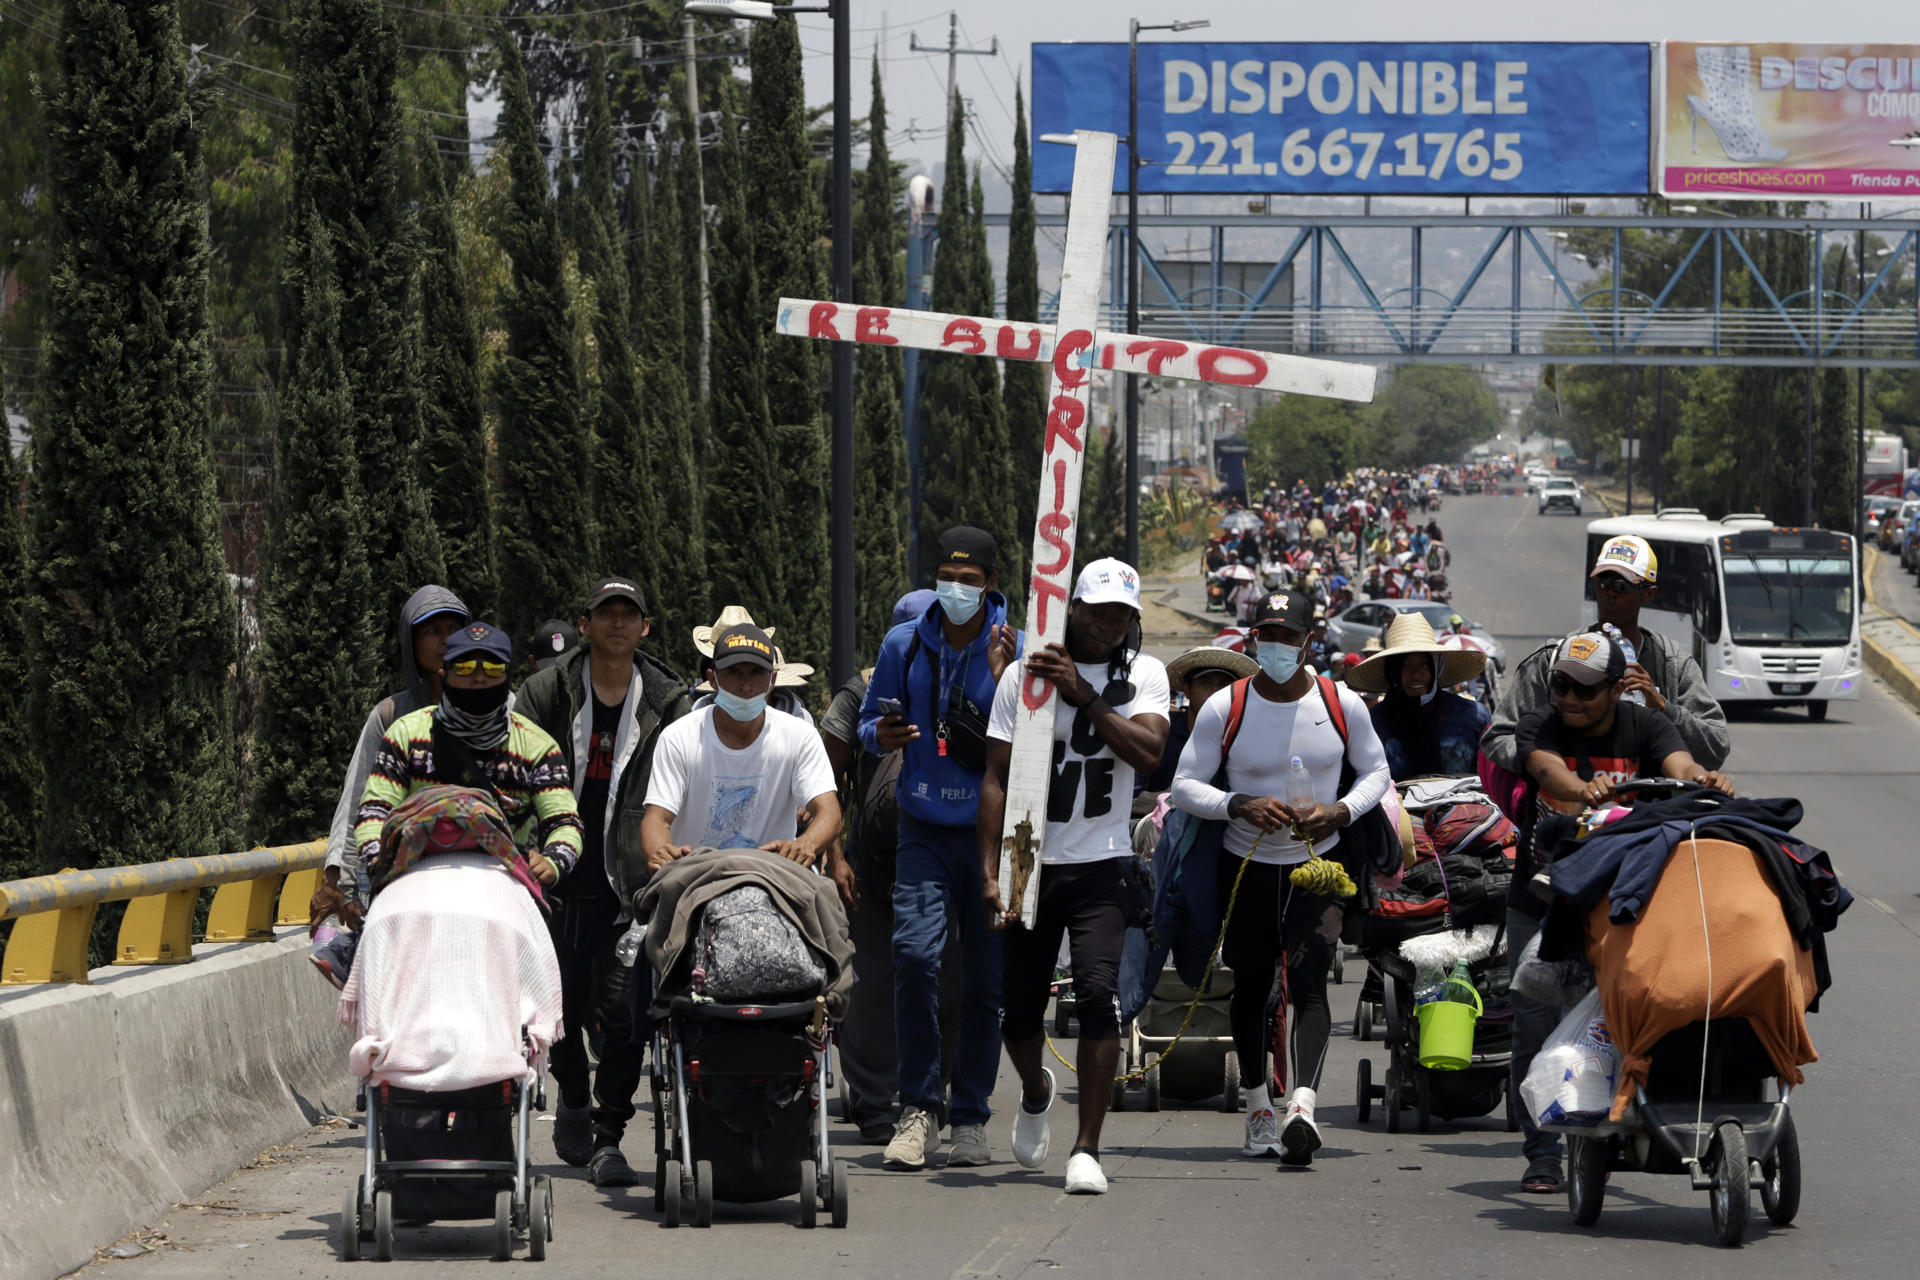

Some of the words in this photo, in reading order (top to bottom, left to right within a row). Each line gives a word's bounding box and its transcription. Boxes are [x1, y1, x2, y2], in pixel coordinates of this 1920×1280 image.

[1164, 60, 1528, 115] DISPONIBLE
[1759, 57, 1920, 91] DESCU
[1165, 128, 1523, 181] 221.667.1765
[1684, 168, 1826, 188] priceshoes.com
[1851, 172, 1901, 188] Tienda
